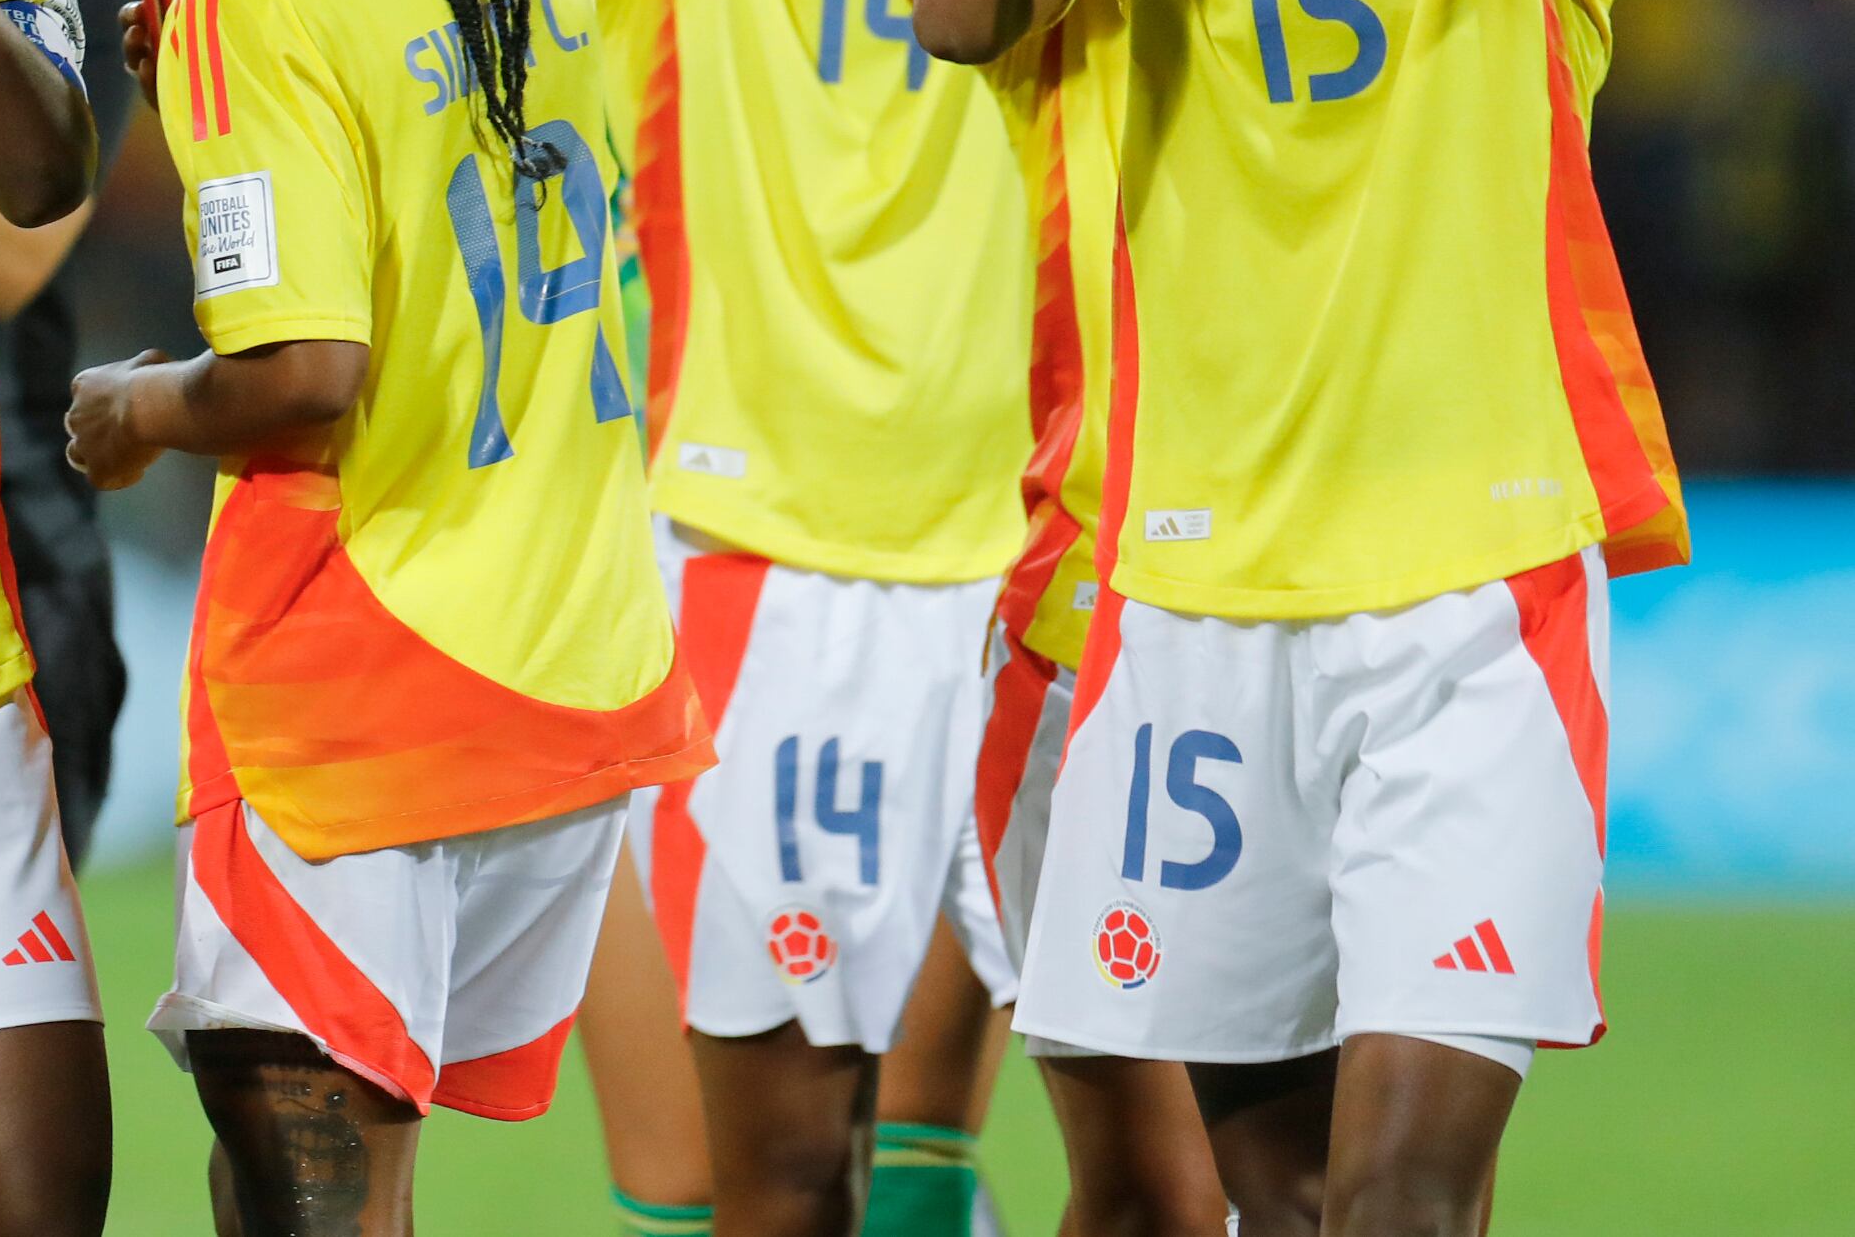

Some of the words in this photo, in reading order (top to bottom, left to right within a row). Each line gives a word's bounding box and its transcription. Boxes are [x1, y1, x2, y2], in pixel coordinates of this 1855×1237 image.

[201, 195, 249, 216] FOOTBALL
[201, 210, 251, 239] UNITES
[218, 231, 255, 253] World
[216, 257, 239, 271] FIFA
[446, 119, 633, 469] 19
[775, 736, 883, 885] 14
[1121, 723, 1243, 891] 15
